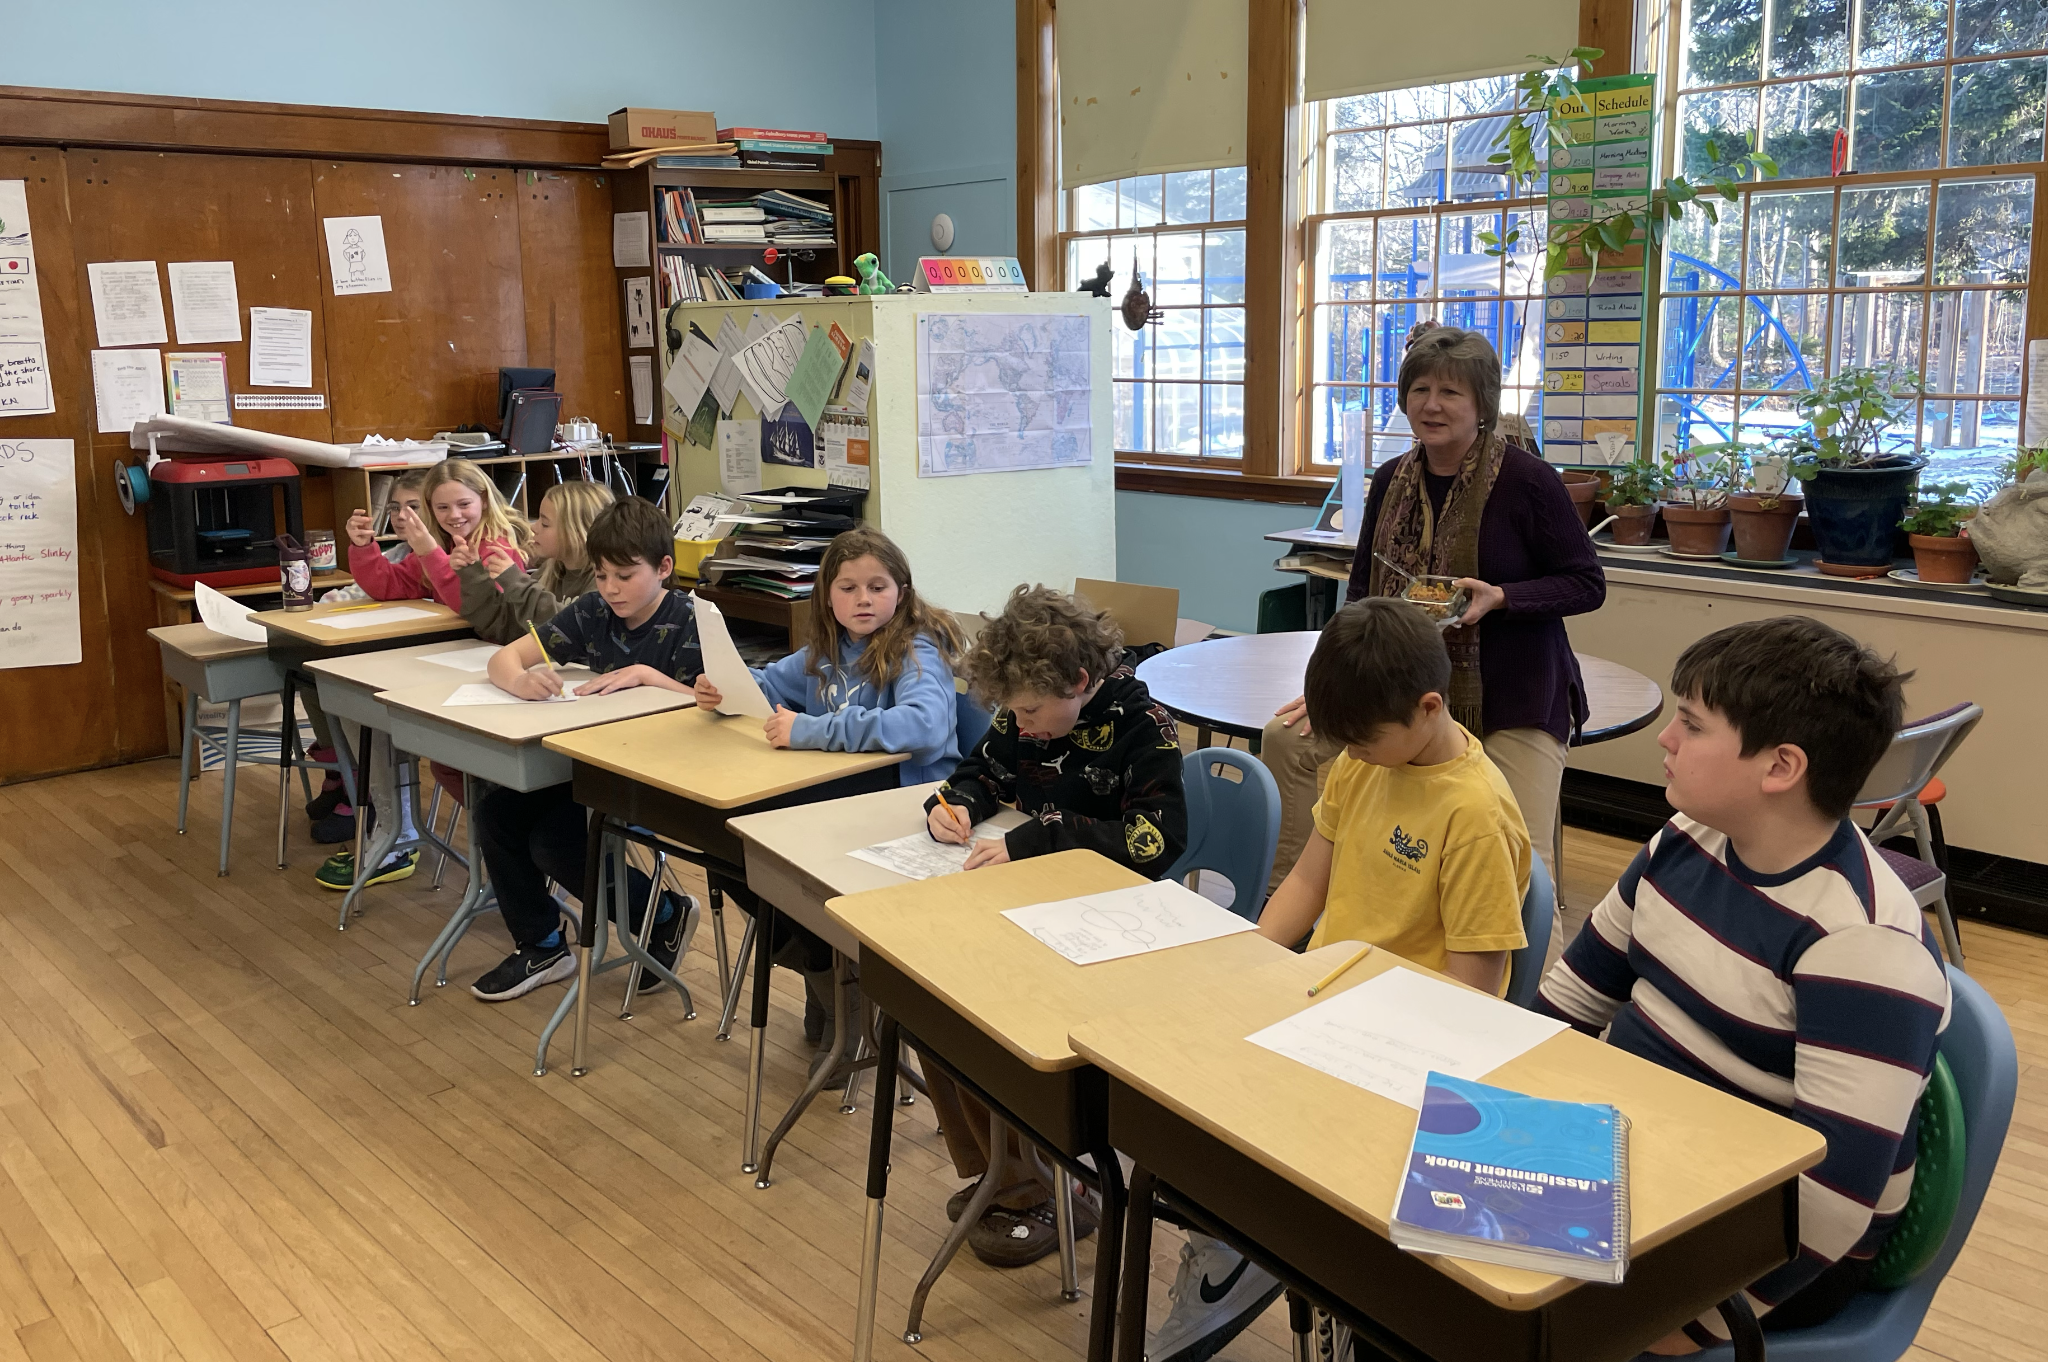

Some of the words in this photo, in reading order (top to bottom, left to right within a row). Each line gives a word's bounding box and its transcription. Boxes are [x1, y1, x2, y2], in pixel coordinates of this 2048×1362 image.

[1598, 95, 1649, 111] Schedule
[641, 126, 677, 139] OHAUS
[7, 356, 36, 367] breaths
[1551, 351, 1569, 361] 1:50
[1596, 353, 1623, 363] Writing
[4, 368, 18, 376] the
[20, 366, 43, 374] shore
[16, 376, 33, 387] fall
[1591, 374, 1630, 390] Specials
[9, 501, 36, 509] toilet
[4, 543, 26, 552] thing
[40, 547, 72, 561] Slinky
[10, 594, 34, 606] gooey
[40, 589, 72, 601] sparkly
[12, 622, 22, 631] do
[1424, 1154, 1472, 1173] book
[1474, 1163, 1591, 1191] Assignment
